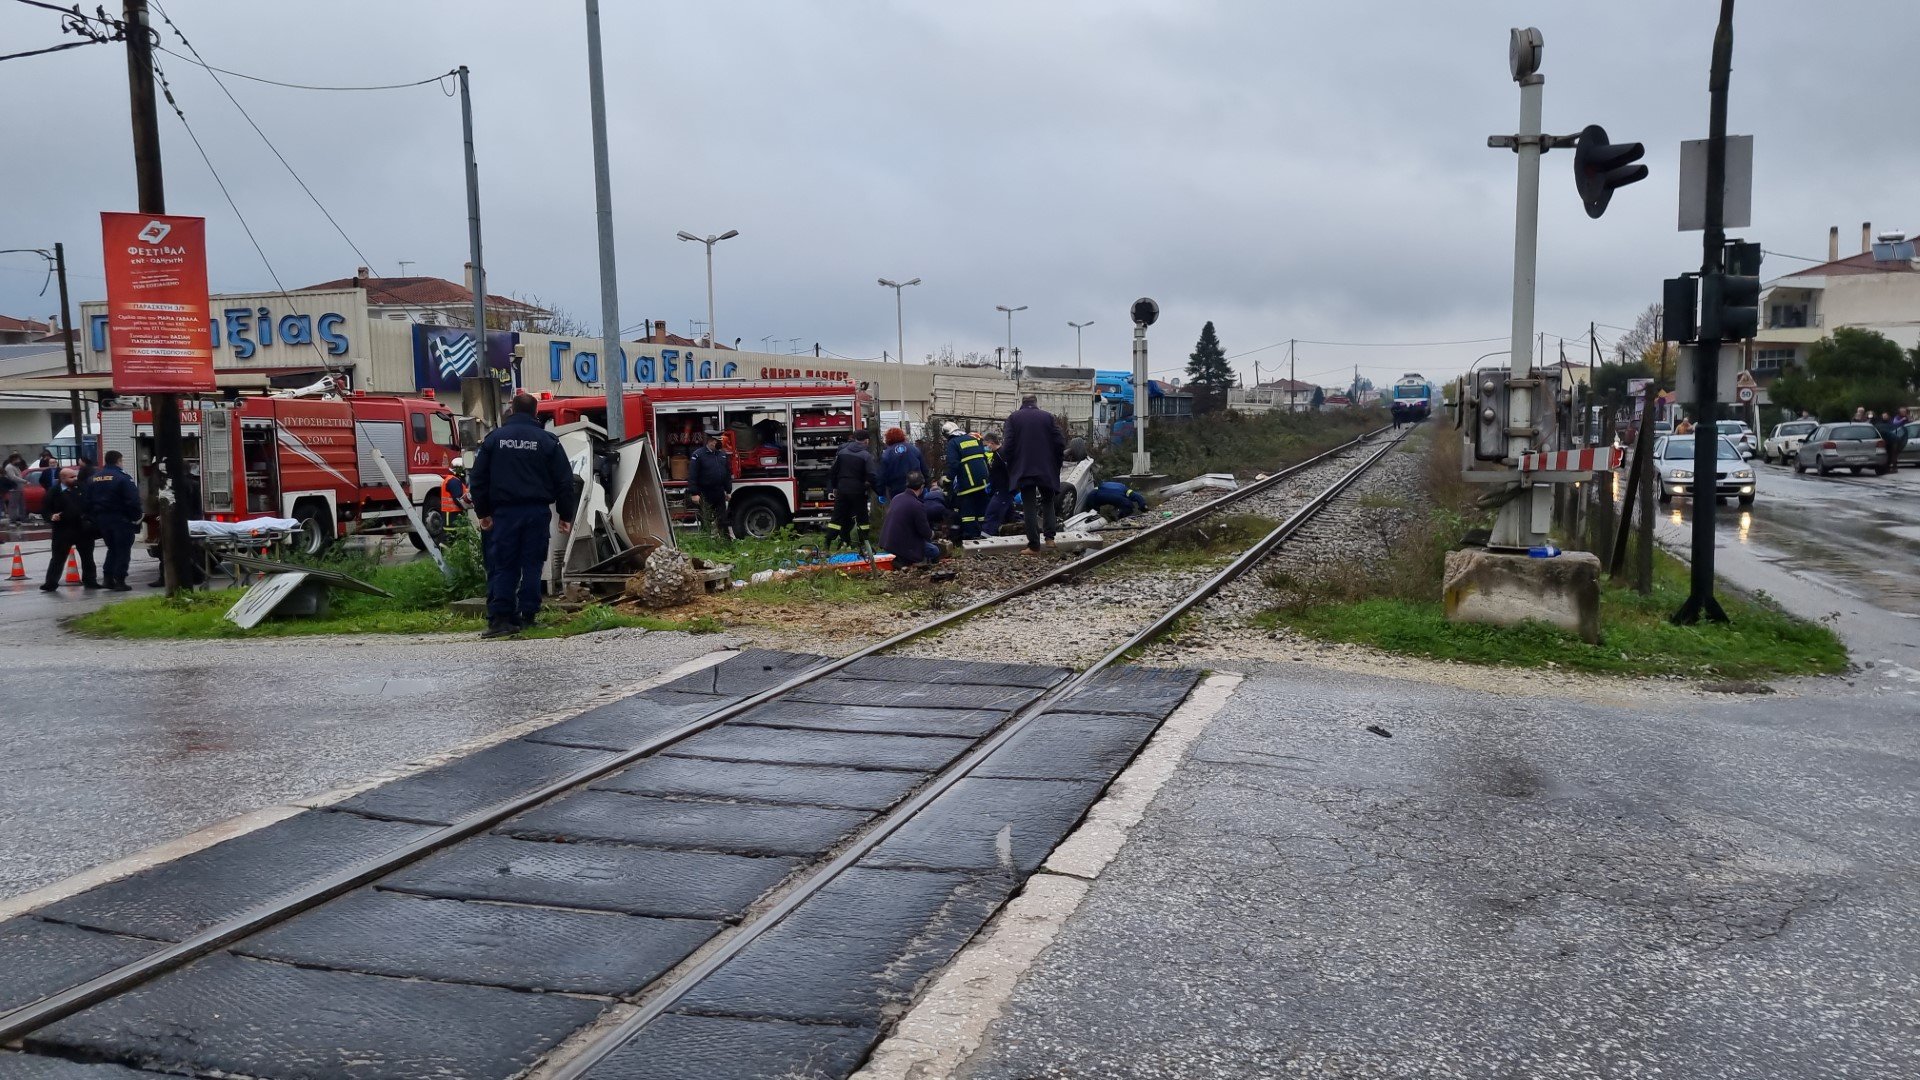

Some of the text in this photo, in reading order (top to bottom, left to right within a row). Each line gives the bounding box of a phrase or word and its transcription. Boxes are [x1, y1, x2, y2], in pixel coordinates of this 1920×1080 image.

[127, 246, 186, 256] ΦΕΣΤΙΒΑΛ
[133, 303, 173, 311] ΠΑΡΑΣΚΕΥΗ
[284, 416, 353, 428] ΠΥΡΟΣΒΕΣΤΙΚΟ
[306, 435, 334, 446] ΣΩΜΑ
[499, 439, 538, 451] POLICE
[417, 451, 430, 465] 199
[92, 475, 114, 483] POLICE
